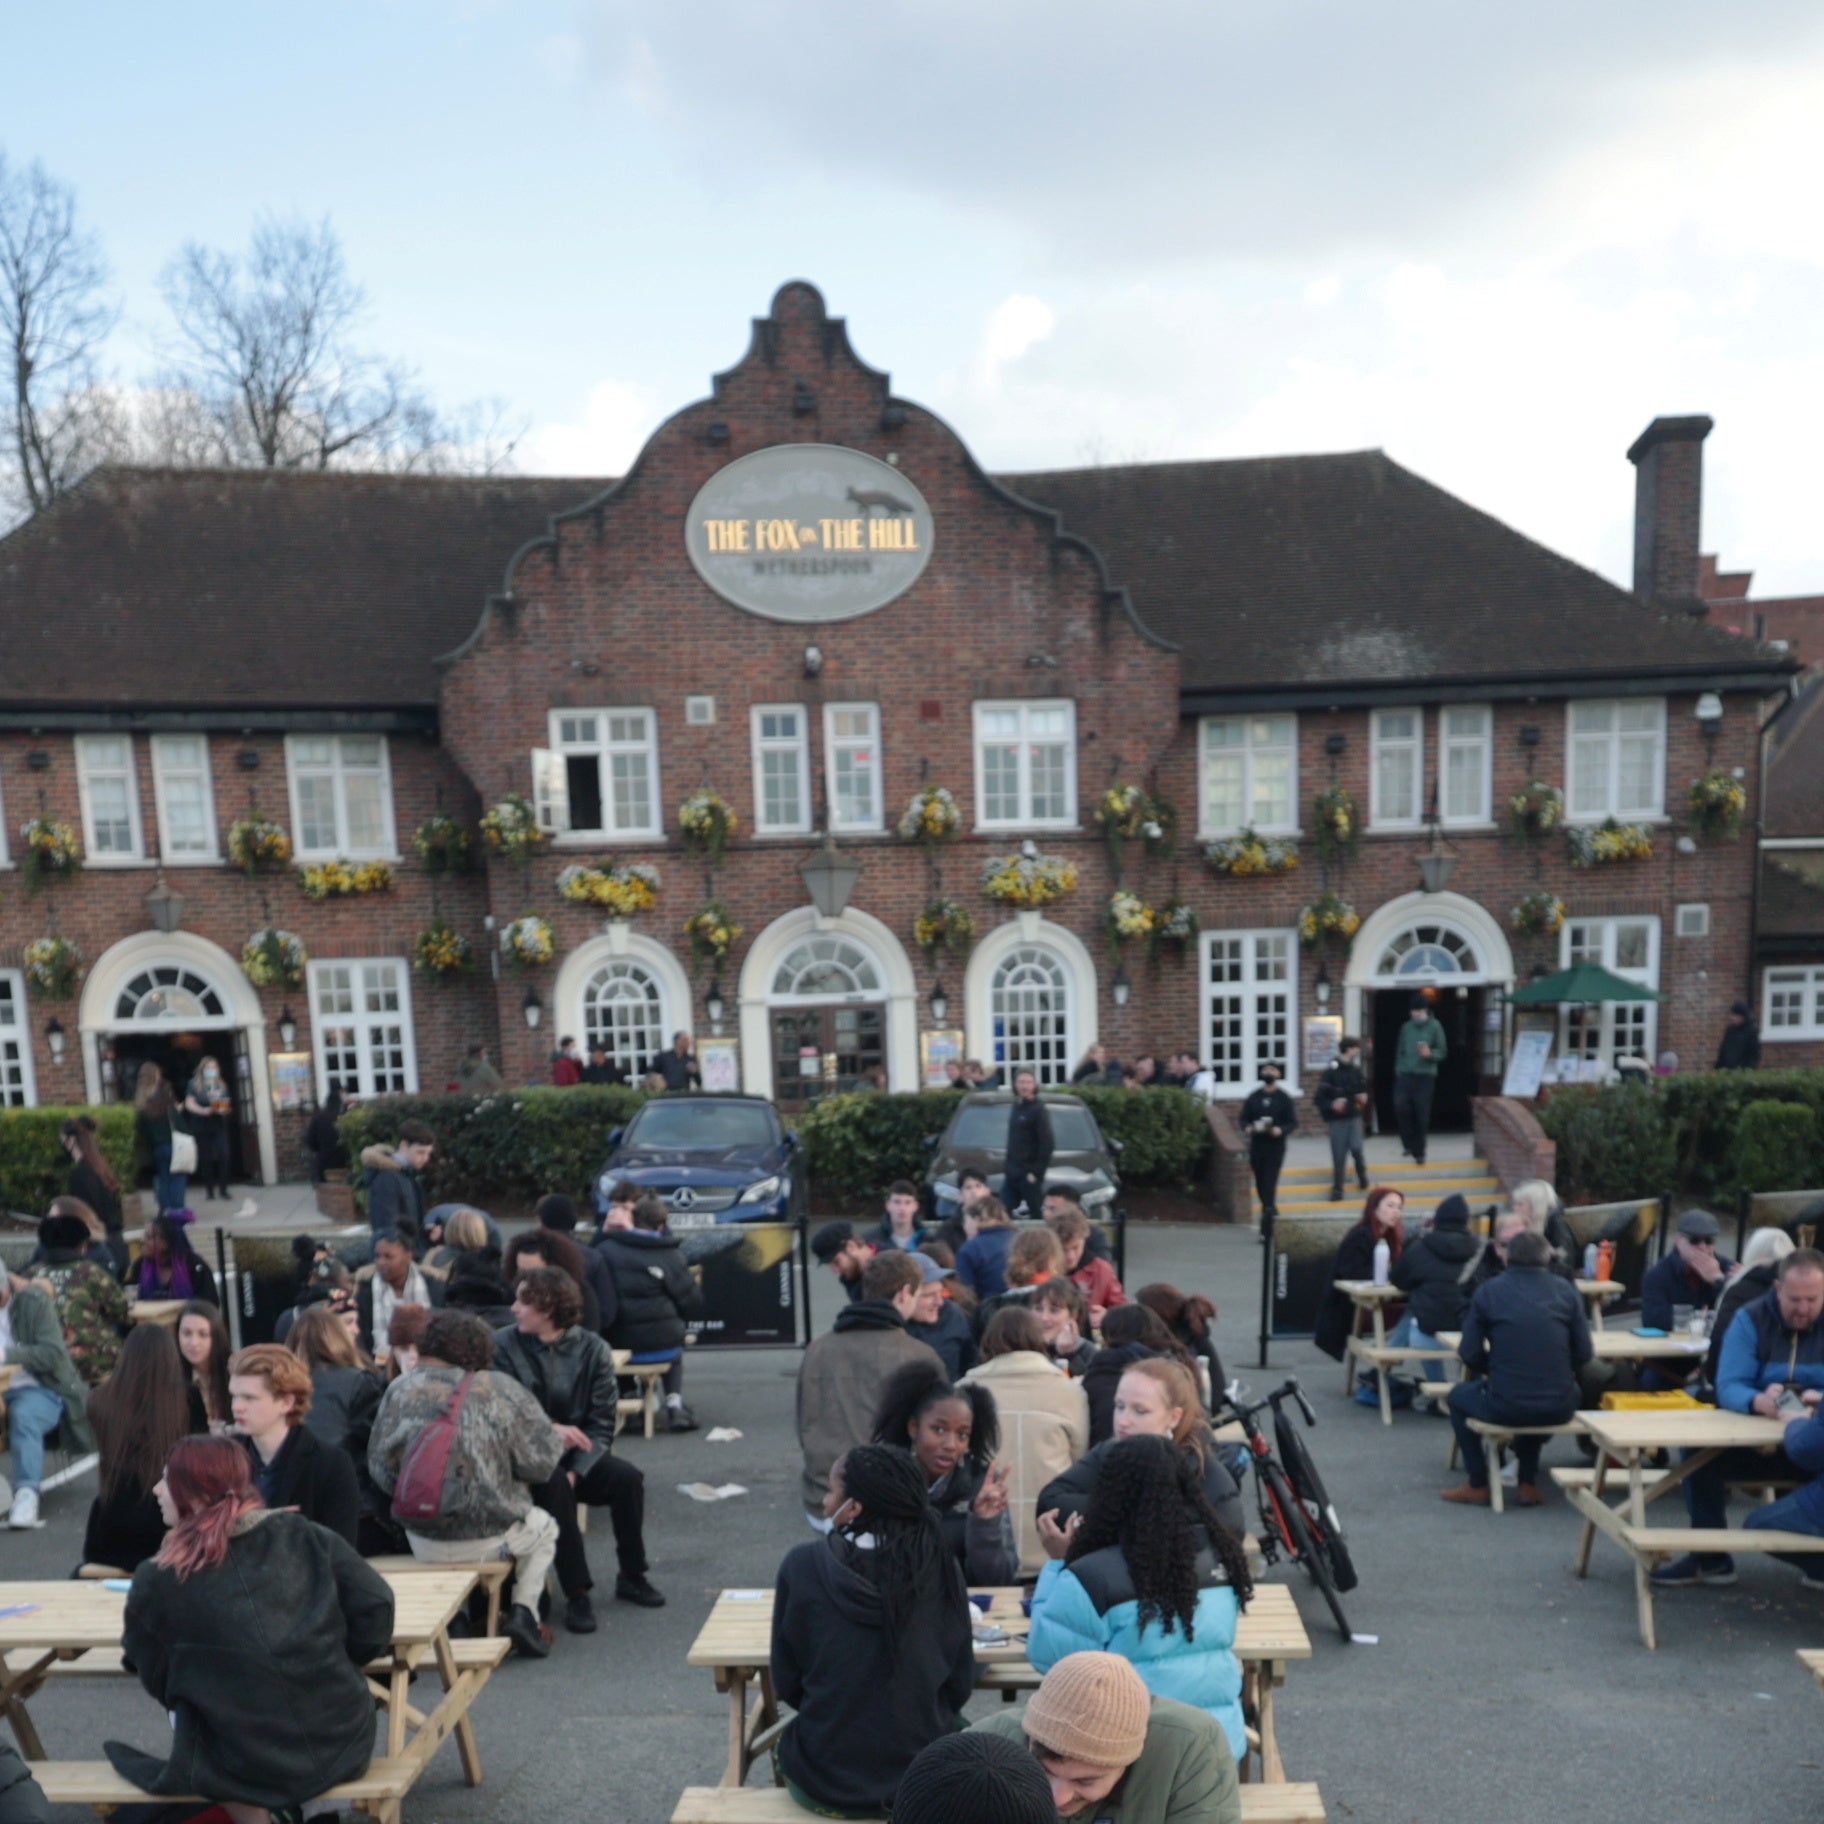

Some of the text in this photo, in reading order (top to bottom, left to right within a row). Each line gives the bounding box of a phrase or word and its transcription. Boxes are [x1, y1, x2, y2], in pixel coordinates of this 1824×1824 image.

[703, 519, 751, 553] THE
[755, 519, 802, 553] FOX
[816, 518, 865, 552] THE
[868, 518, 921, 553] HILL
[752, 556, 873, 576] WETHERSPOON
